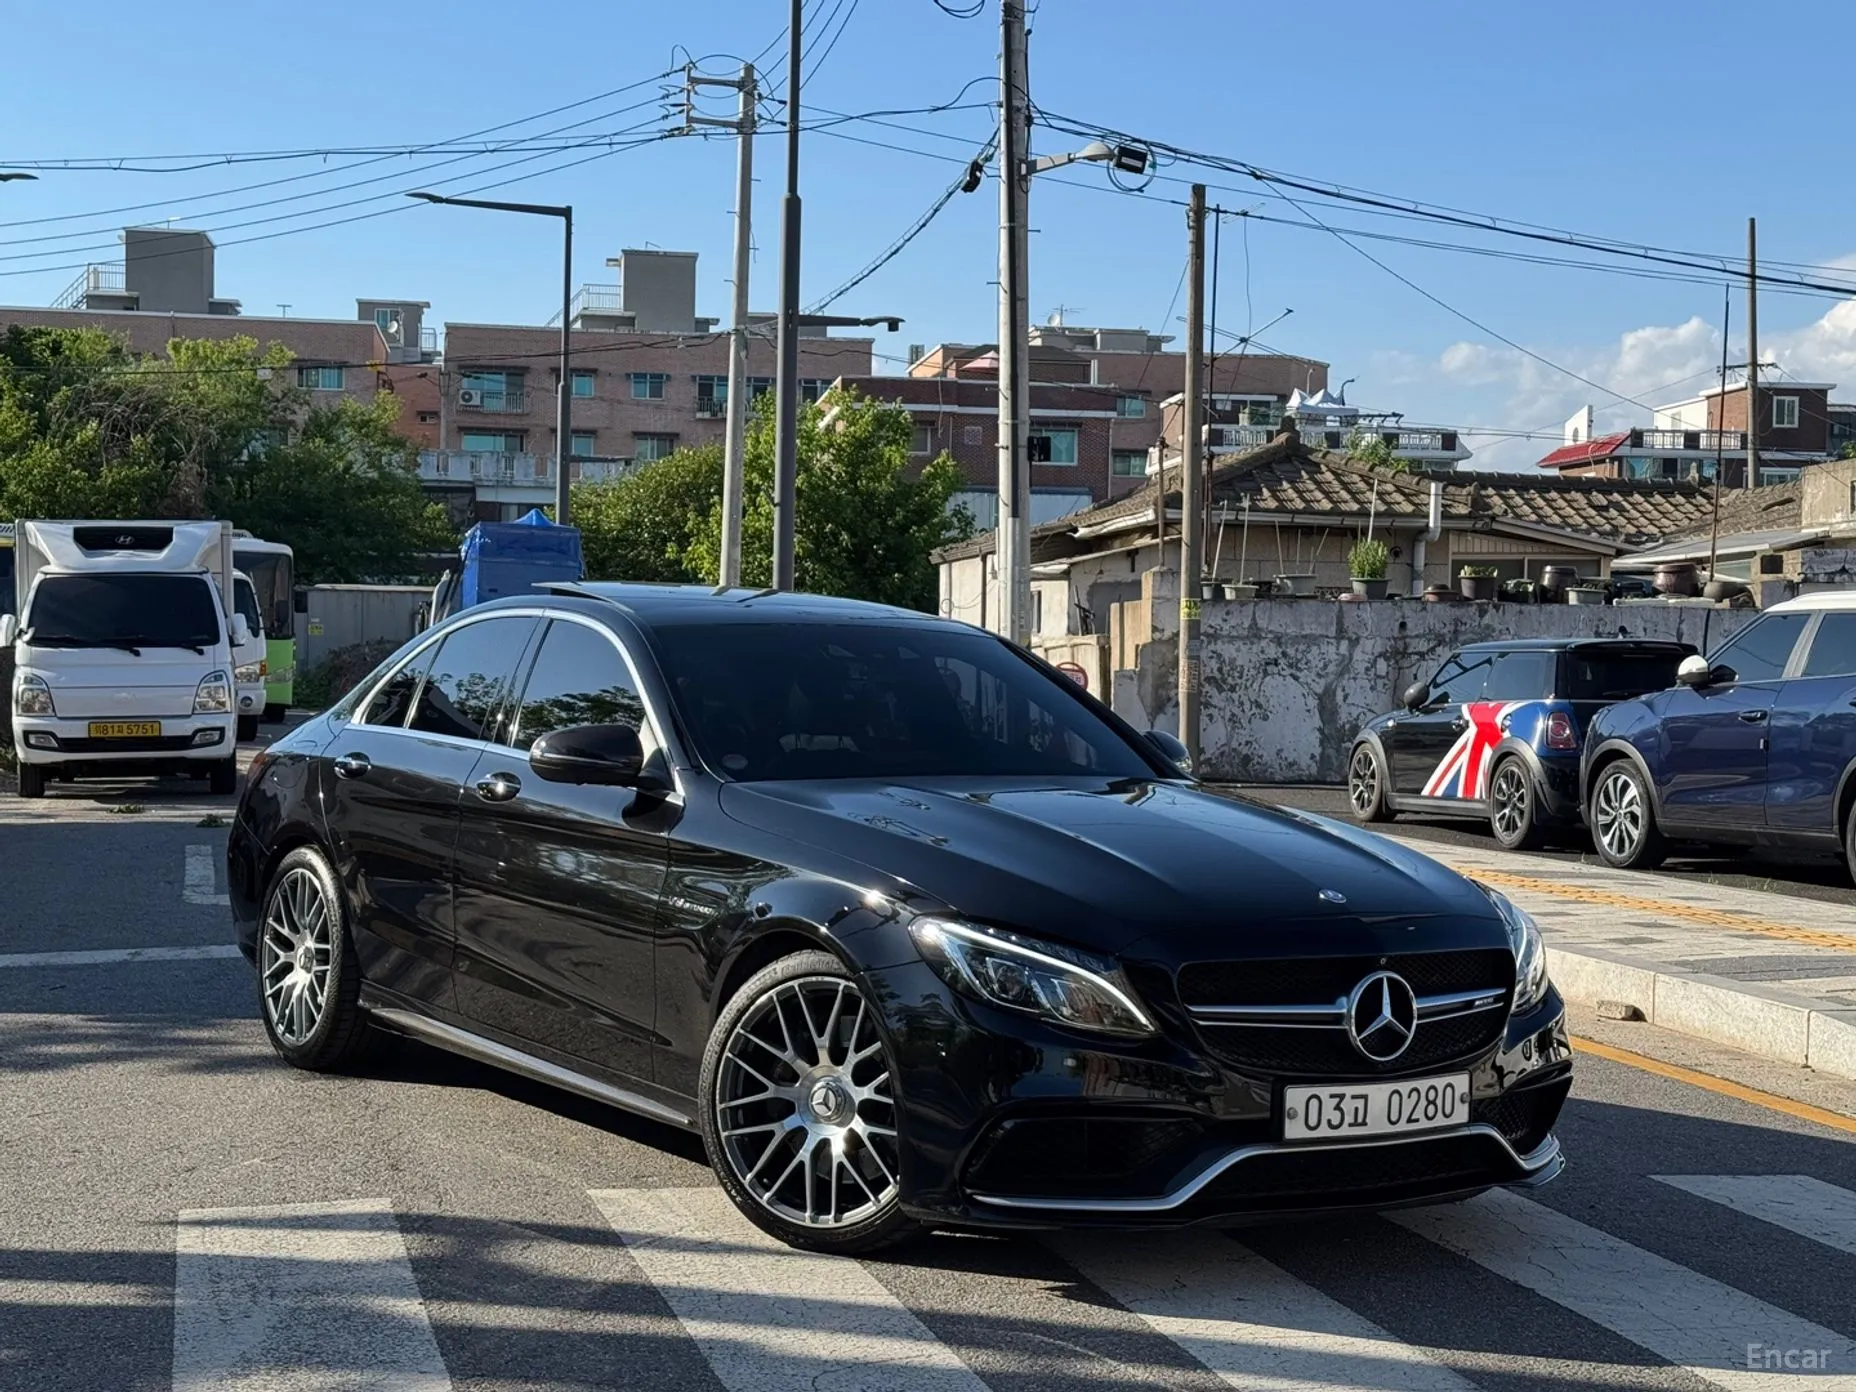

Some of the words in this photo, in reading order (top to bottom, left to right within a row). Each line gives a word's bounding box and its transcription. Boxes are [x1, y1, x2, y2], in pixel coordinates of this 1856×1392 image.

[126, 724, 154, 735] 5751
[1304, 1093, 1369, 1131] 03고
[1387, 1082, 1456, 1126] 0280
